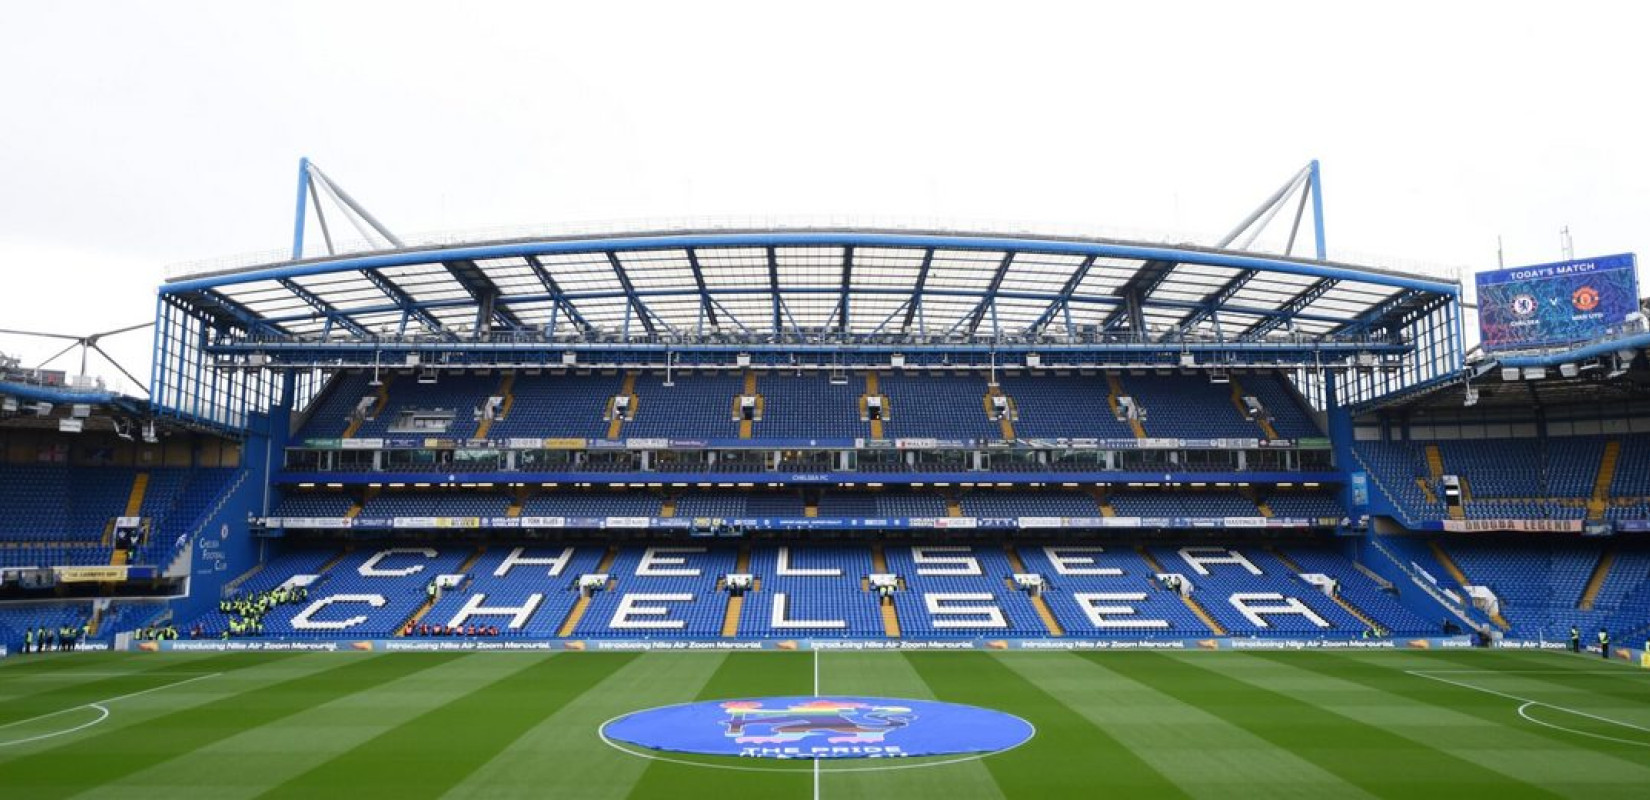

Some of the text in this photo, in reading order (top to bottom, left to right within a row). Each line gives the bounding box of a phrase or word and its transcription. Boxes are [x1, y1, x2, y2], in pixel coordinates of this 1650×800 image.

[1510, 263, 1595, 281] TODAY'S MATCH
[1523, 520, 1572, 530] LEGEND
[359, 548, 1264, 576] CHELSEA
[290, 594, 1331, 629] CHELSEA
[172, 642, 225, 651] Introducing
[386, 642, 438, 651] Introducing
[598, 642, 650, 651] Introducing
[811, 642, 862, 651] Introducing
[1022, 642, 1073, 651] Introducing
[1232, 642, 1284, 651] Introducing
[742, 746, 901, 755] THE PRIDE
